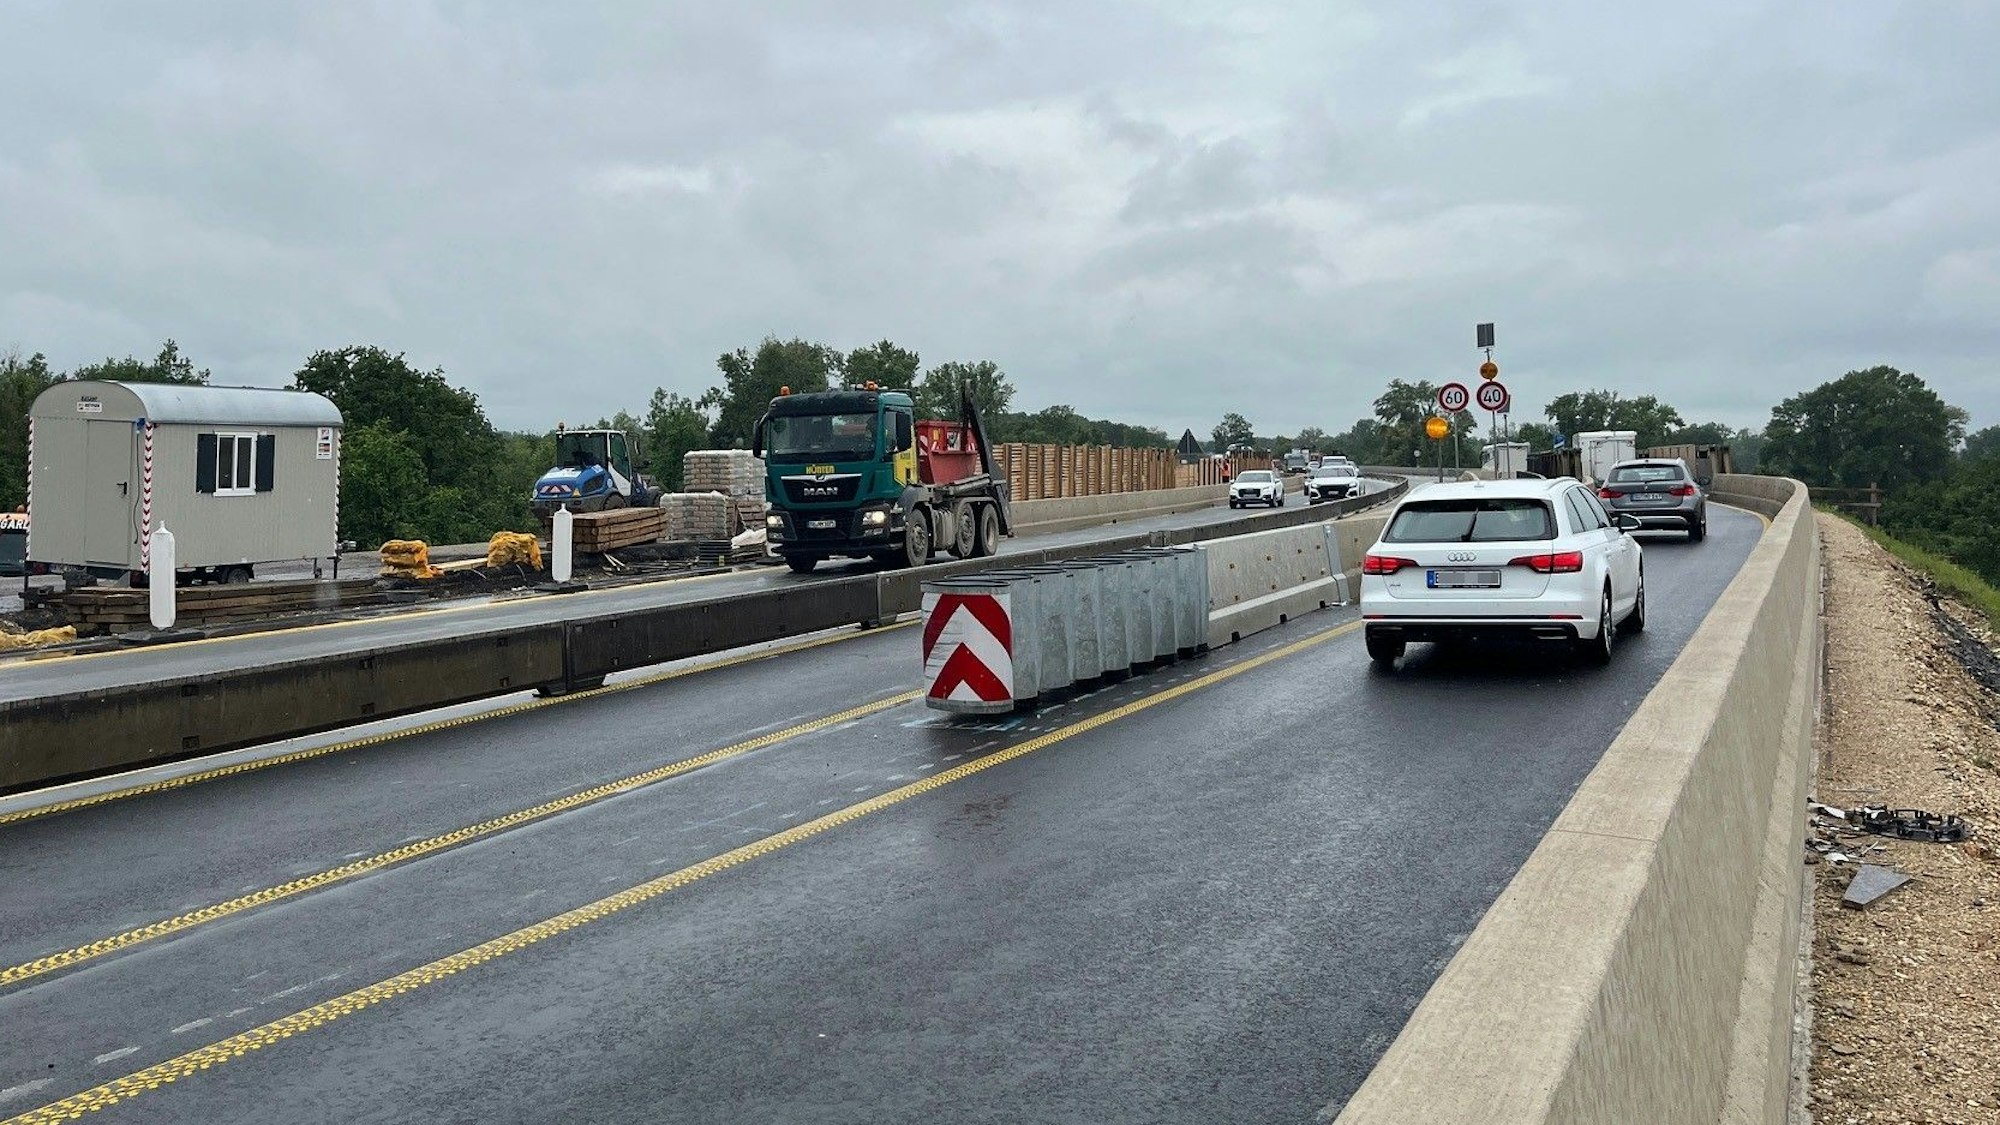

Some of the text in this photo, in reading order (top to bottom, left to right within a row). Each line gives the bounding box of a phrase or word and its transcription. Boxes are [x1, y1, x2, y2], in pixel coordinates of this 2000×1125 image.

[1445, 391, 1463, 404] 60
[1483, 388, 1501, 403] 40
[803, 486, 839, 497] MAN
